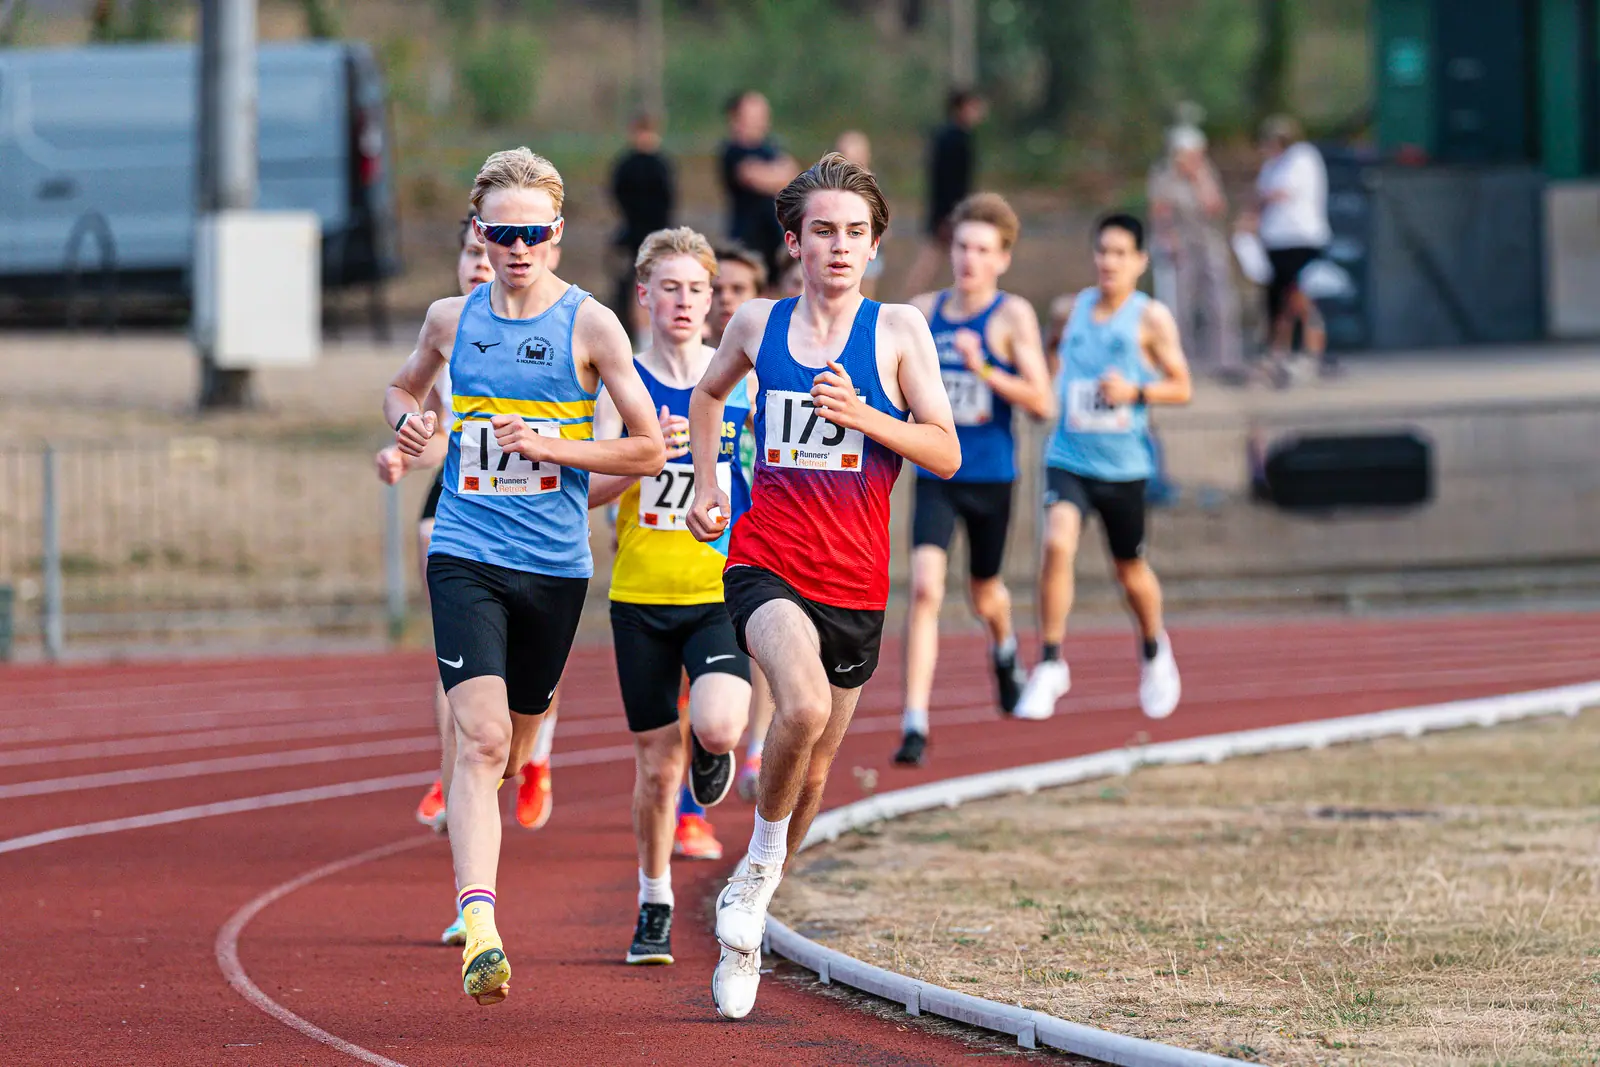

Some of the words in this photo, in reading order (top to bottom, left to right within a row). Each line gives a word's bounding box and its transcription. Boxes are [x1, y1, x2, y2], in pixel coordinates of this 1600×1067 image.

[799, 450, 830, 459] Runners'
[799, 459, 827, 468] Retreat
[498, 477, 529, 485] Runners'
[500, 485, 527, 493] Retreat
